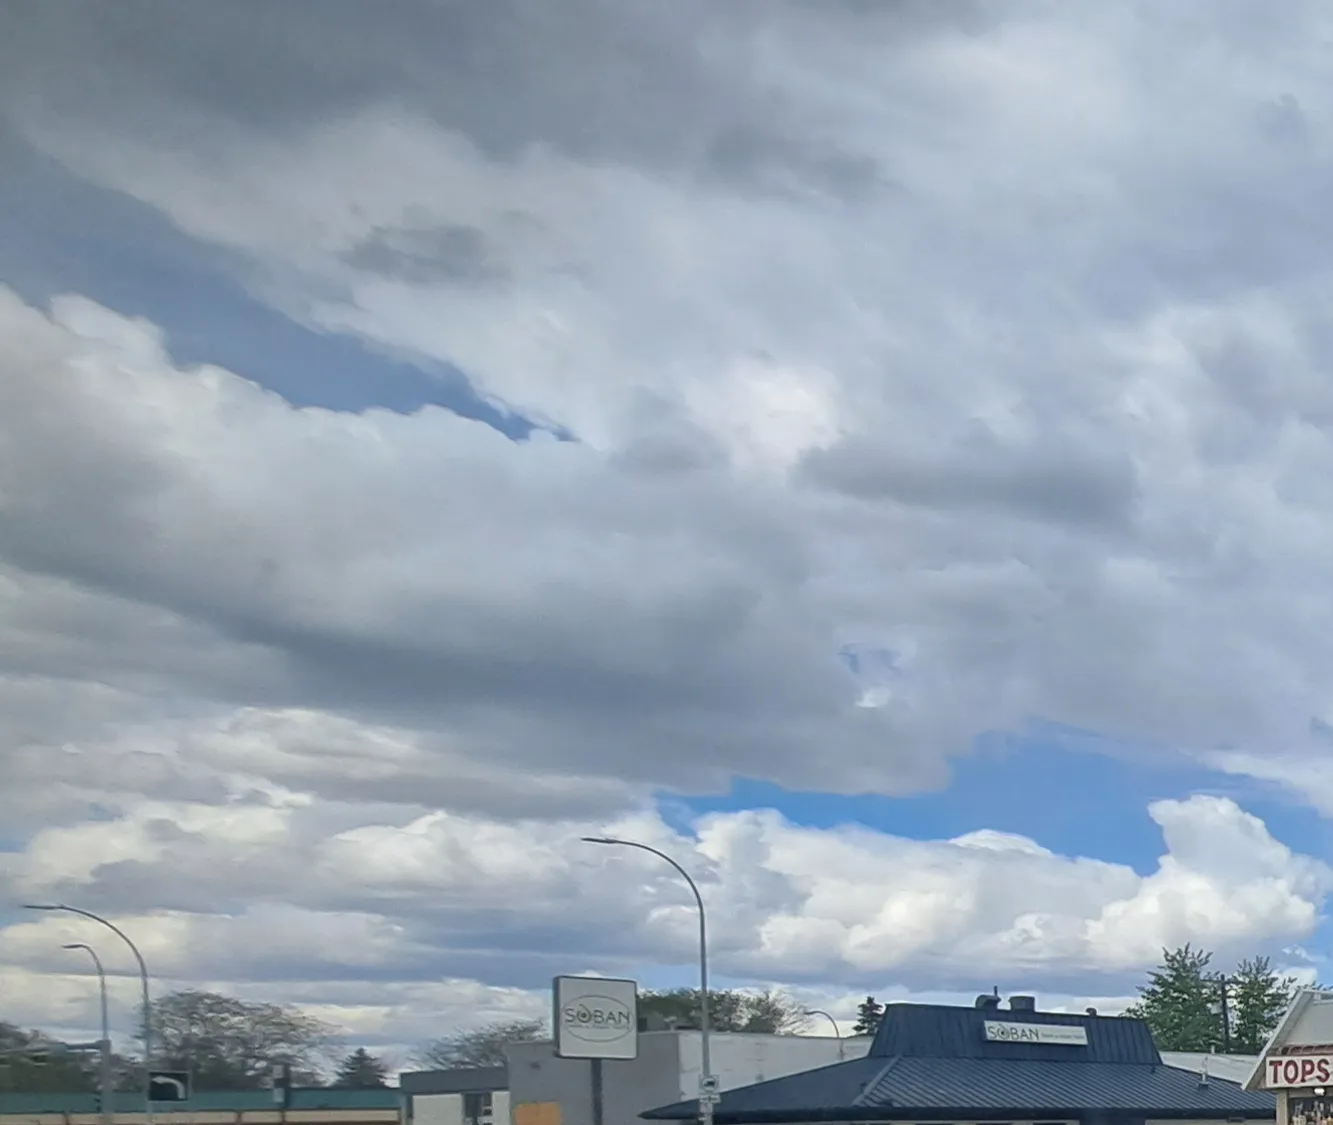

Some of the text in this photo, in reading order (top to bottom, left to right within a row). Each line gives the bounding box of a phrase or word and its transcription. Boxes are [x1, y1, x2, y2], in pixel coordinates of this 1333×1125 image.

[564, 1003, 631, 1025] SOBAN
[987, 1023, 1040, 1040] SOBAN
[1268, 1058, 1331, 1085] TOPS
